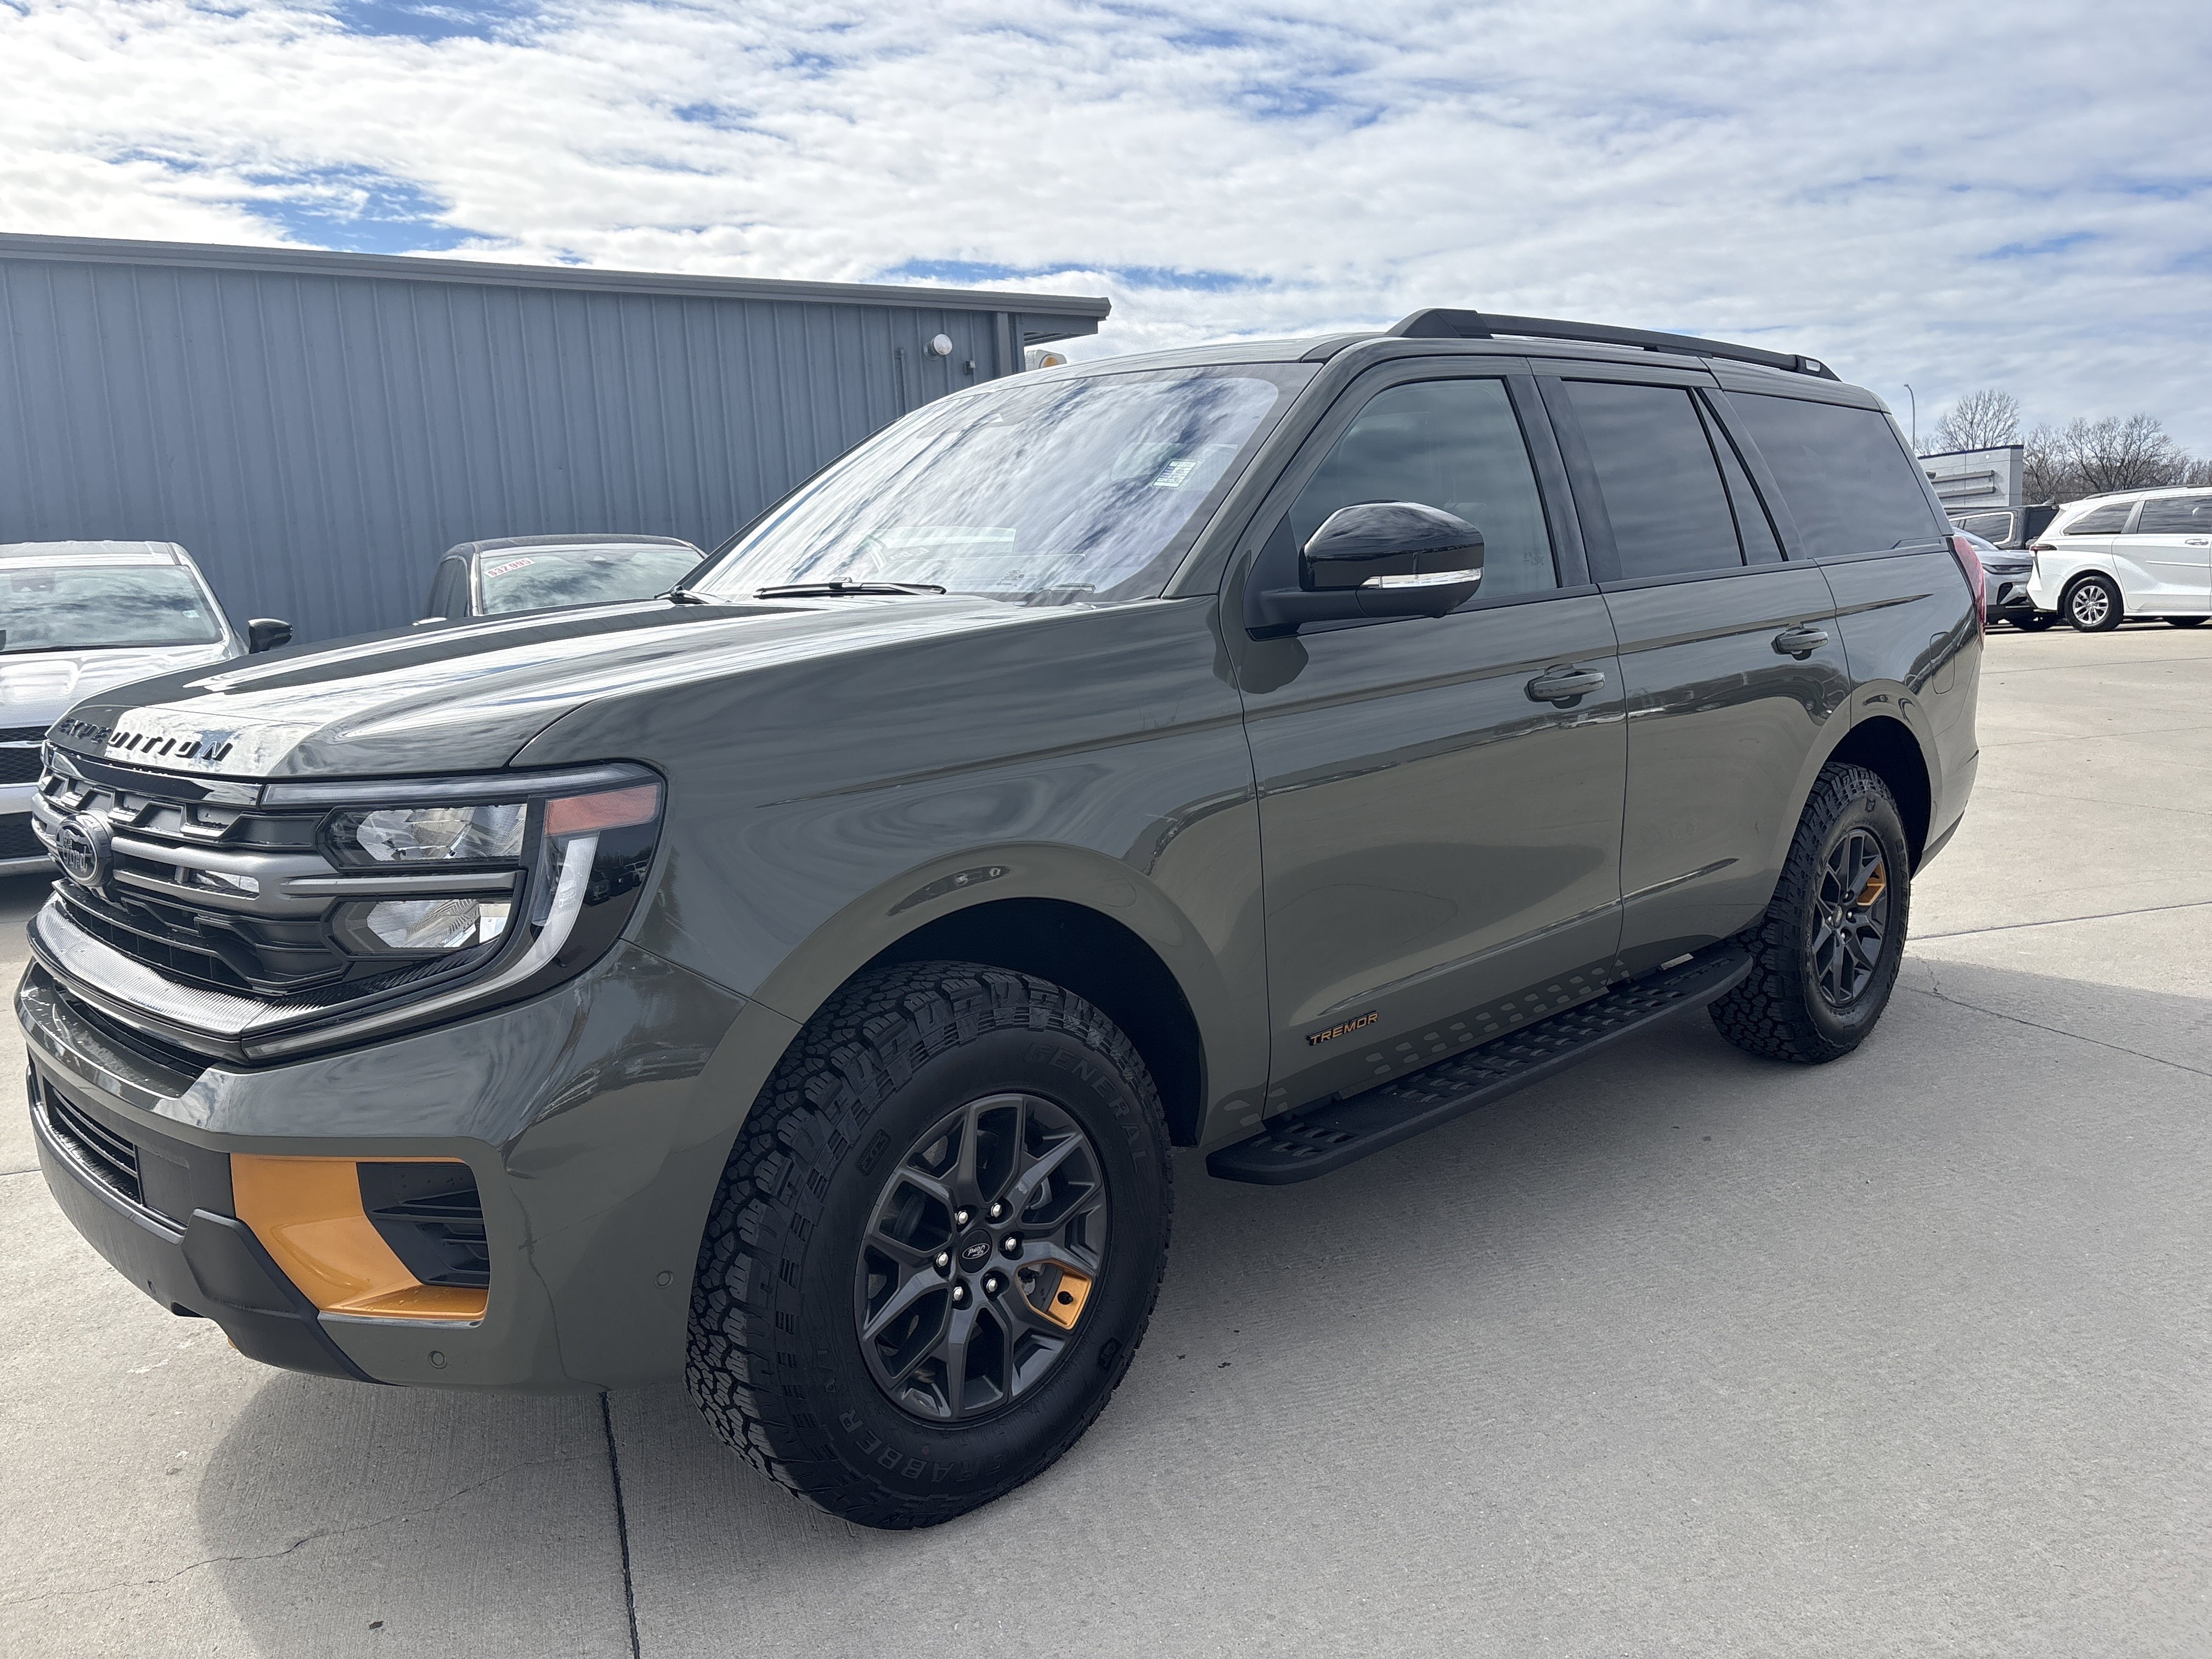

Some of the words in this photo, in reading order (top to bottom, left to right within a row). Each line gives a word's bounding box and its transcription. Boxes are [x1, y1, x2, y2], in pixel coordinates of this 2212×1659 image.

[58, 718, 233, 761] EXPEDITION
[63, 830, 89, 873] Ford
[1307, 1011, 1379, 1045] TREMOR
[1023, 1041, 1149, 1174] GENERAL
[837, 1406, 1009, 1483] GRABBER
